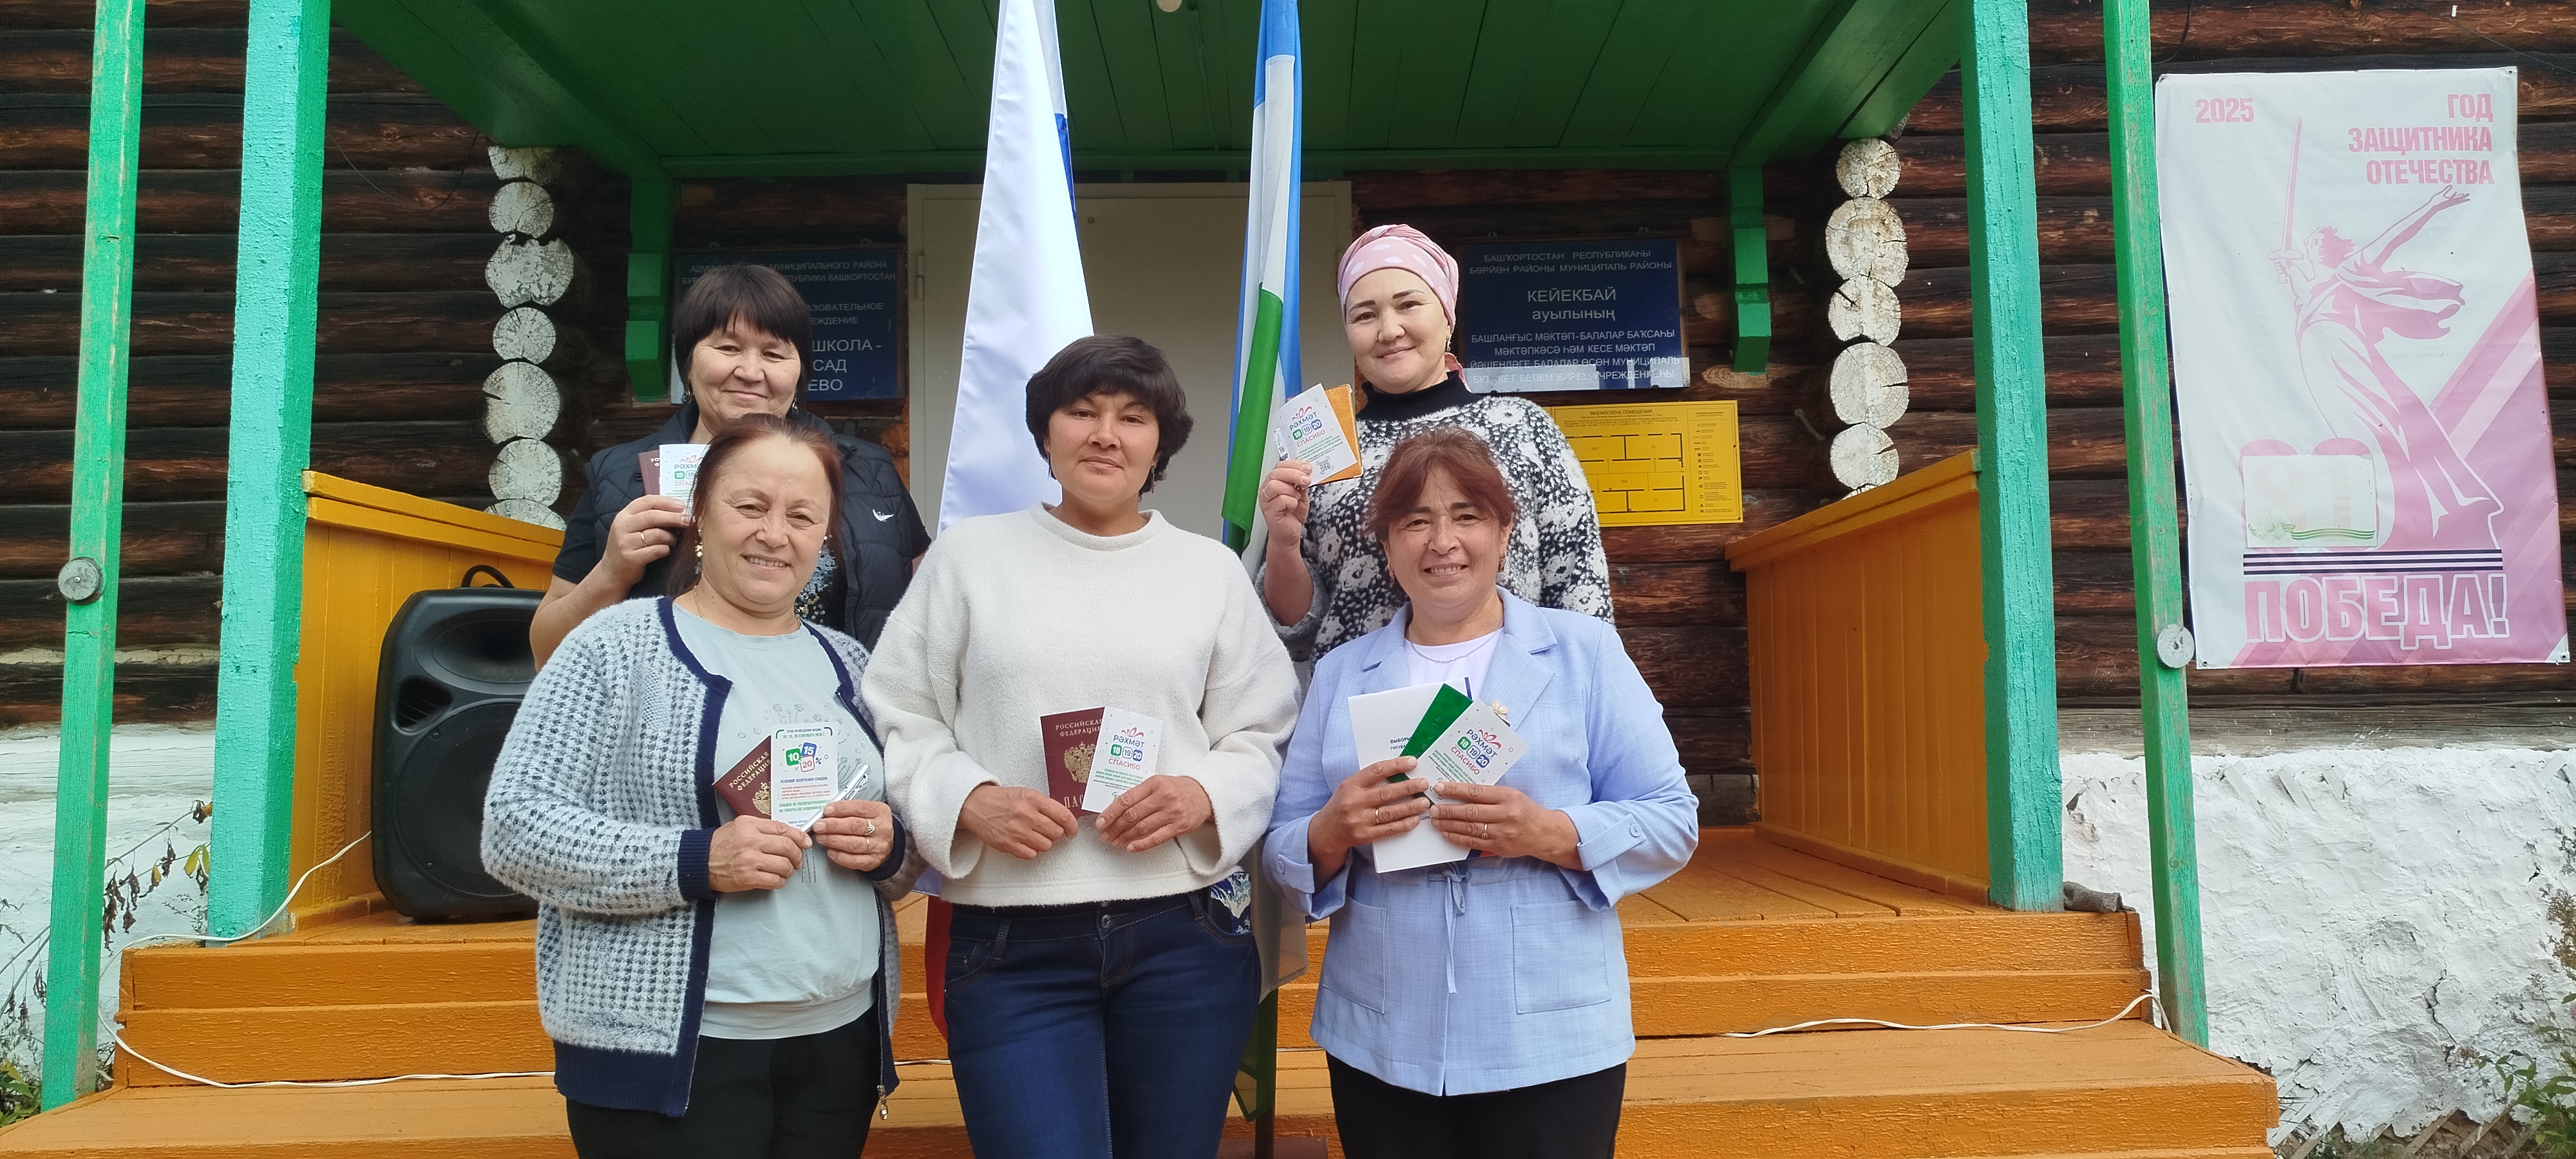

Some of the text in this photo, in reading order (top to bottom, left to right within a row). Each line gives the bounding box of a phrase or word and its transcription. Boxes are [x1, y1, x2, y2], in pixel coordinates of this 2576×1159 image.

[2195, 97, 2255, 123] 2025
[2447, 93, 2494, 122] ГОД
[2347, 127, 2492, 156] ЗАЩИТНИКА
[2366, 160, 2495, 185] ОТЕЧЕСТВА
[853, 260, 887, 269] РАЙОНА
[1513, 264, 1555, 273] РАЙОНЫ
[1560, 263, 1627, 272] МУНИЦИПАЛЬ
[1630, 260, 1672, 269] РАЙОНЫ
[828, 273, 896, 281] БАШКОРТОСТАН
[1528, 287, 1616, 302] КЕЙЕКБАЙ
[808, 303, 884, 312] АЗОВАТЕЛЬНОЕ
[811, 316, 858, 325] ЕЖДЕНИЕ
[1532, 310, 1616, 323] ауылының
[812, 339, 873, 352] ШКОЛА
[1587, 344, 1613, 353] КЕСЕ
[813, 359, 847, 373] САД
[1613, 357, 1680, 367] МУНИЦИПАЛЬ
[808, 379, 843, 391] ЕВО
[1297, 429, 1325, 447] СПАСИБО
[2243, 574, 2510, 650] ПОБЕДА!
[1056, 718, 1102, 730] РОССИЙСКАЯ
[1059, 726, 1101, 737] ФЕДЕРАЦИЯ
[788, 752, 799, 762] 10
[804, 746, 814, 755] 15
[1133, 751, 1141, 759] 20
[1460, 739, 1488, 766] 18 19 20
[1108, 758, 1141, 770] СПАСИБО
[1451, 746, 1480, 775] СПАСИБО
[729, 751, 770, 788] РОССИЙСКАЯ
[737, 759, 771, 791] ФЕДЕРАЦИЯ
